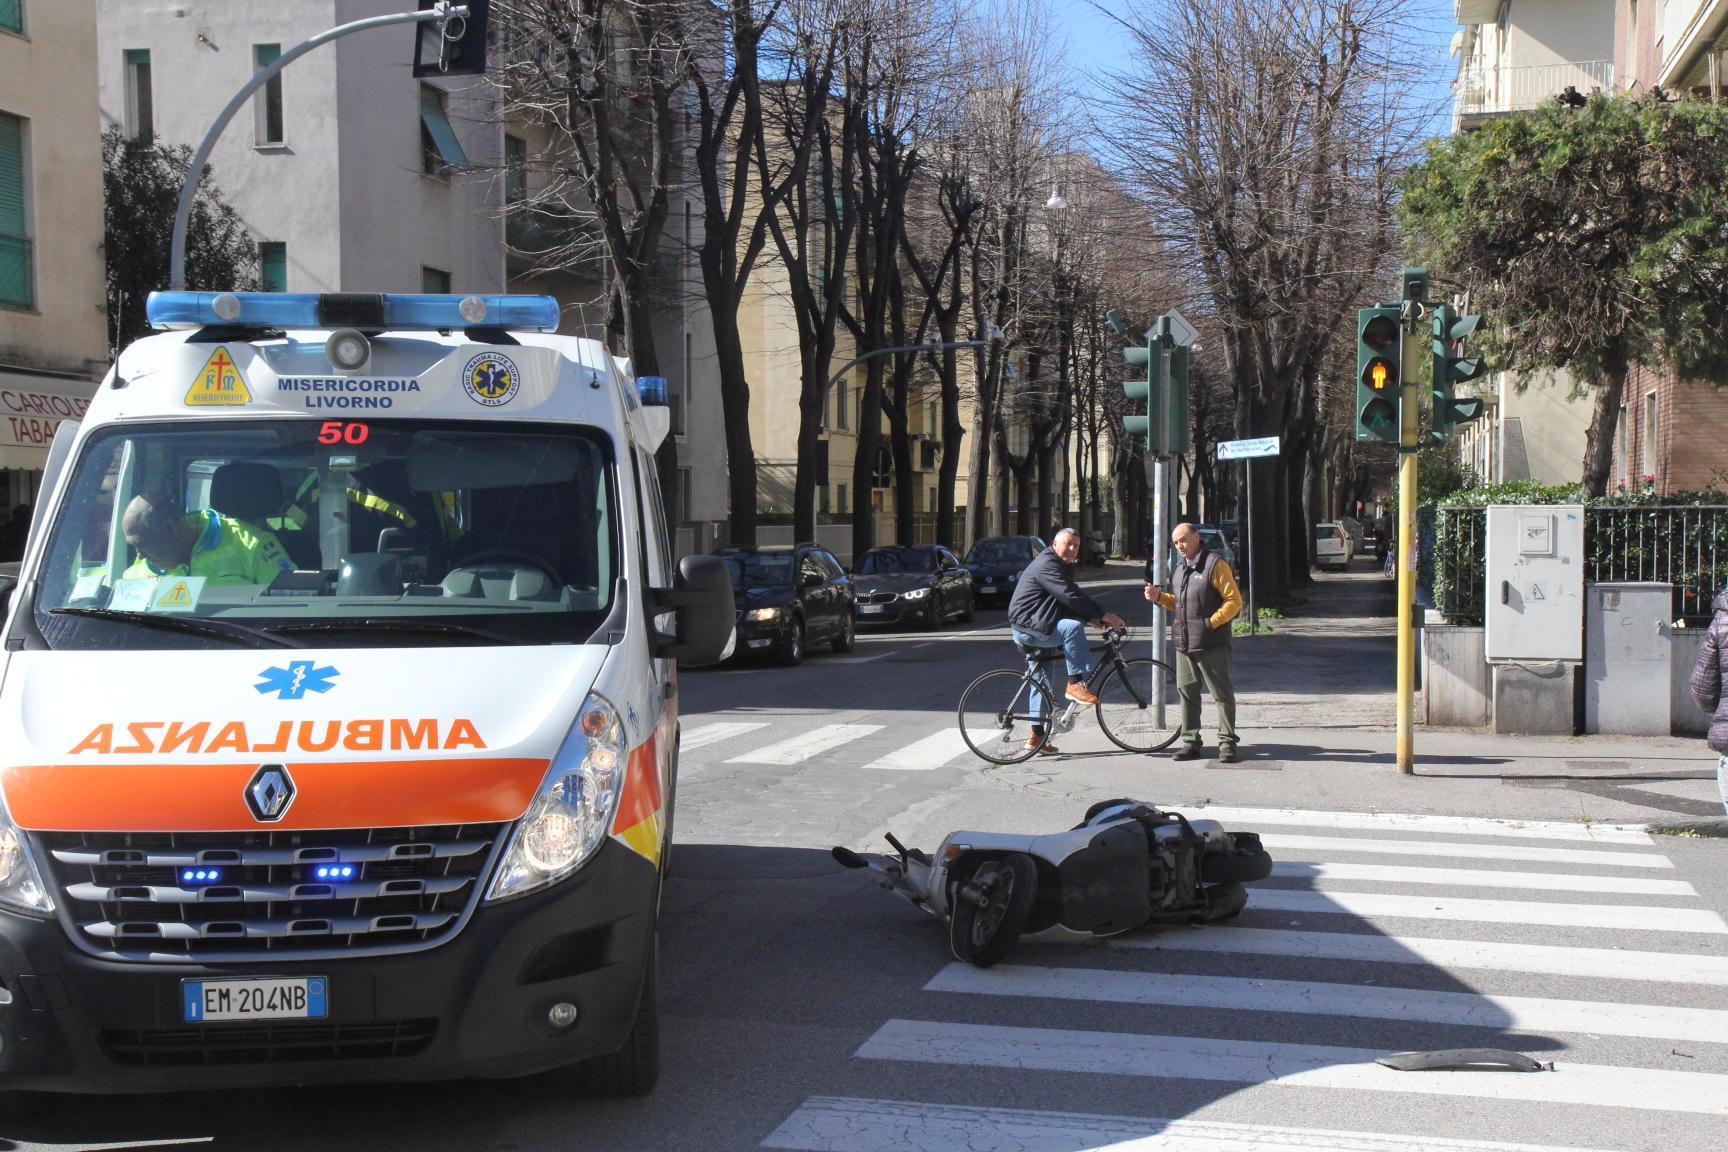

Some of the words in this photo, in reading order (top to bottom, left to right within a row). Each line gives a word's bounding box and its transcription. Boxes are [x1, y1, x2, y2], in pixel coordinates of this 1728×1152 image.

[467, 354, 491, 371] TRAUMA
[494, 354, 508, 364] LIFE
[278, 378, 420, 393] MISERICORDIA
[465, 375, 475, 394] BASIC
[508, 364, 517, 395] SUPPORT
[305, 396, 393, 409] LIVORNO
[317, 421, 369, 445] 50
